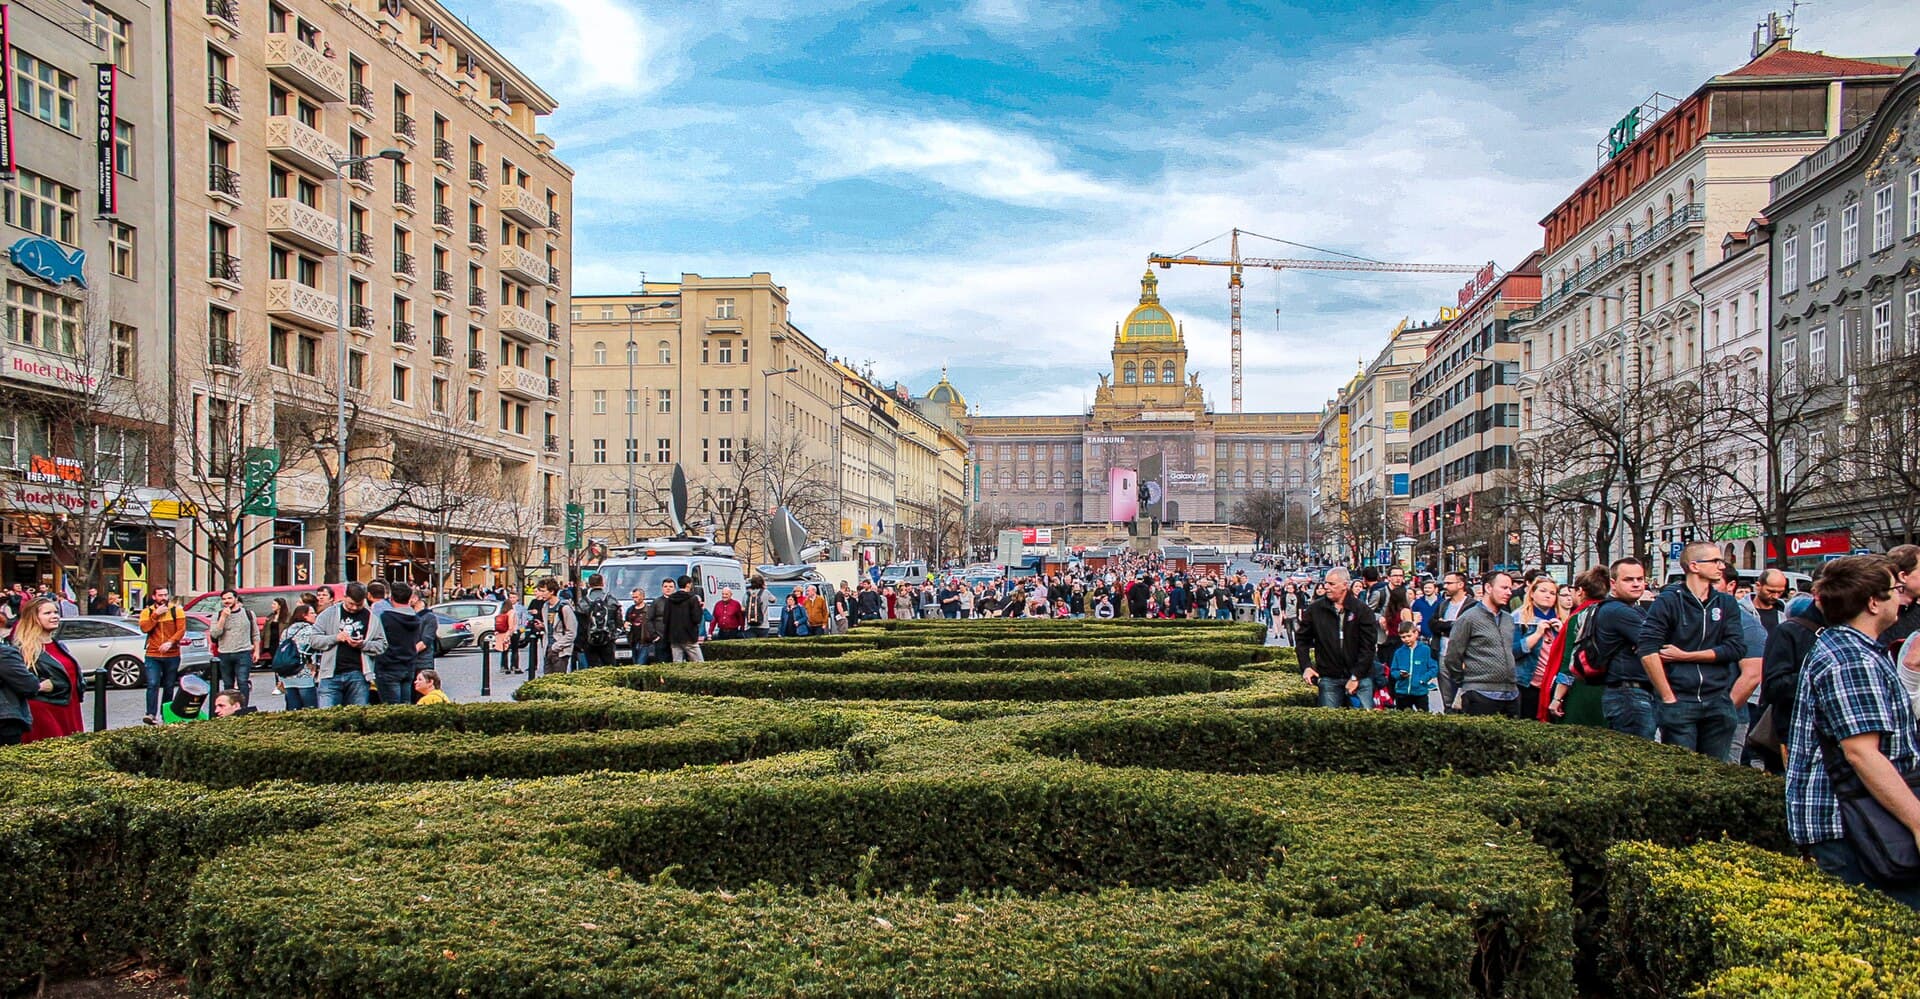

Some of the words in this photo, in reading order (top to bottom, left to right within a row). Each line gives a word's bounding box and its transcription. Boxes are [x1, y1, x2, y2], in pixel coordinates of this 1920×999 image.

[98, 70, 112, 141] Elysee
[13, 356, 52, 378] Hotel
[1087, 436, 1125, 444] SAMSUNG
[1169, 472, 1196, 481] Galaxy
[16, 489, 54, 505] Hotel
[57, 493, 99, 510] Elyse
